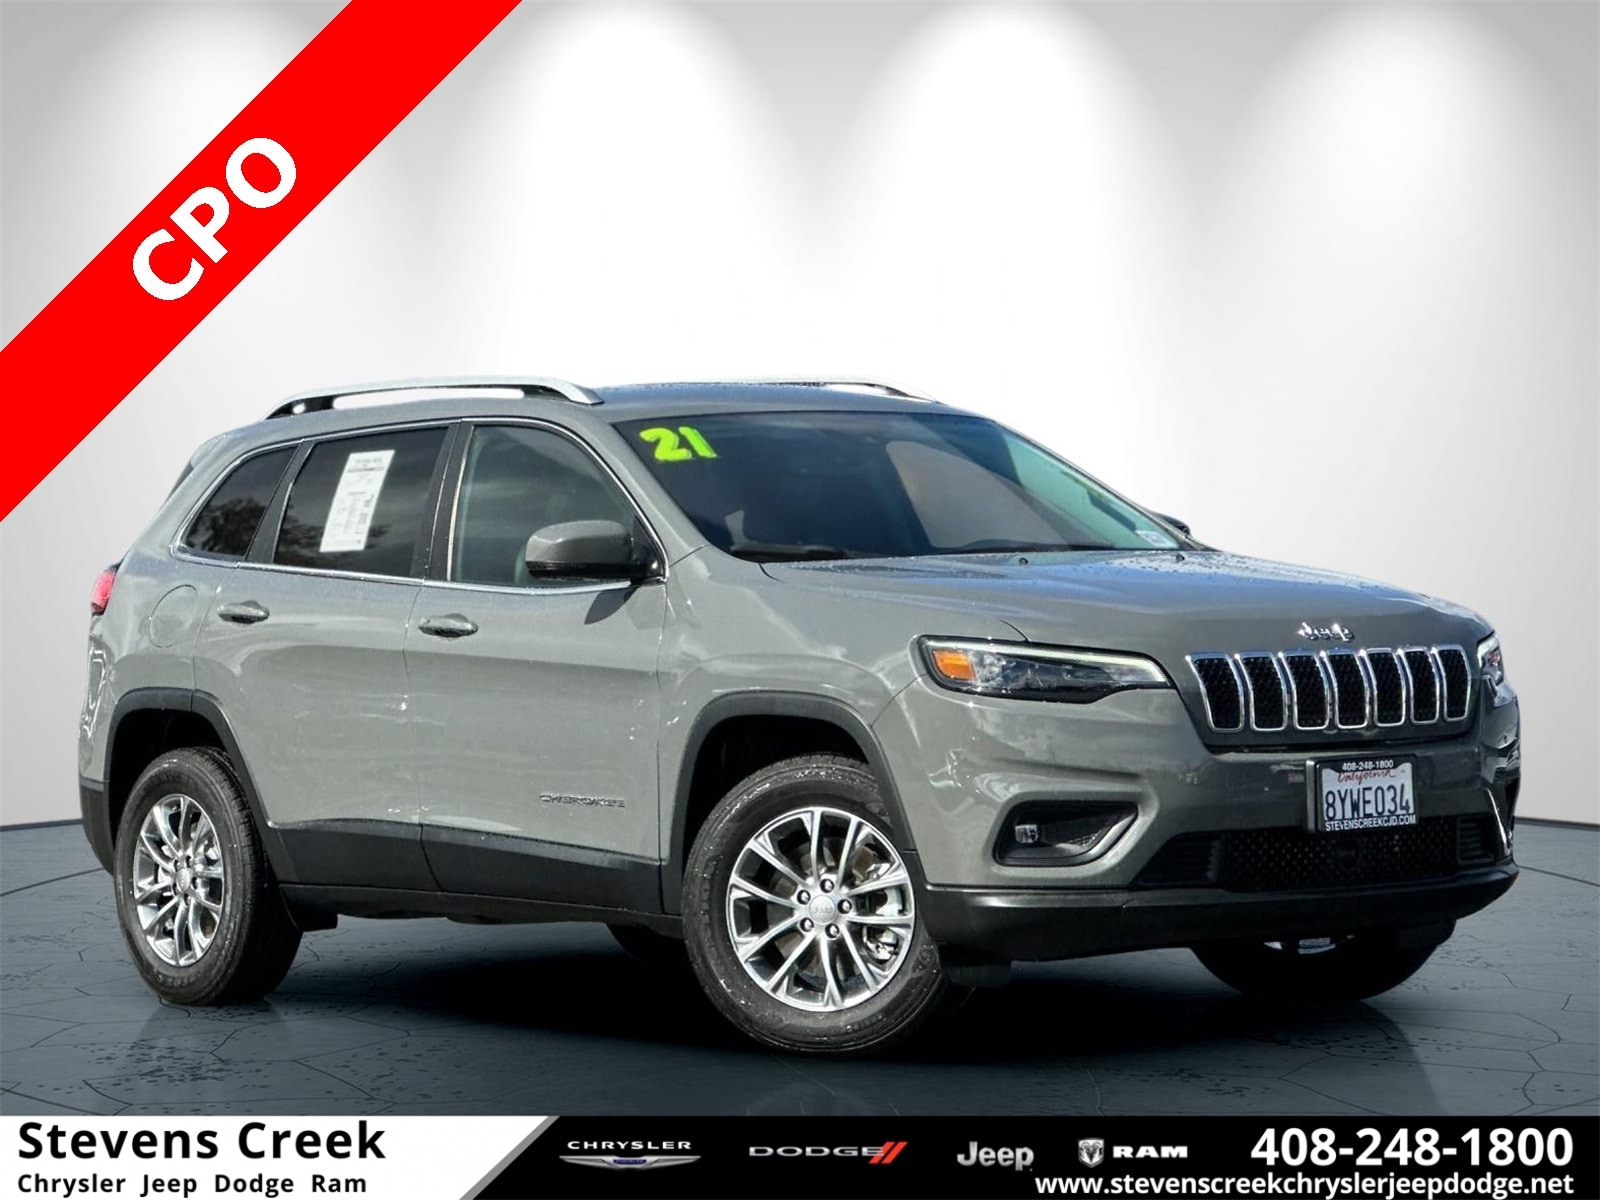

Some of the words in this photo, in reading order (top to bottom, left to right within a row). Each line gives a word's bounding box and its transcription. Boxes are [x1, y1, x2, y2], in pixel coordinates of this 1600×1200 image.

[639, 426, 717, 461] 21
[1342, 759, 1394, 771] 408-248-1800
[1325, 783, 1411, 821] 8YWE034
[1325, 815, 1416, 832] STEVENSCREEKCJD.COM
